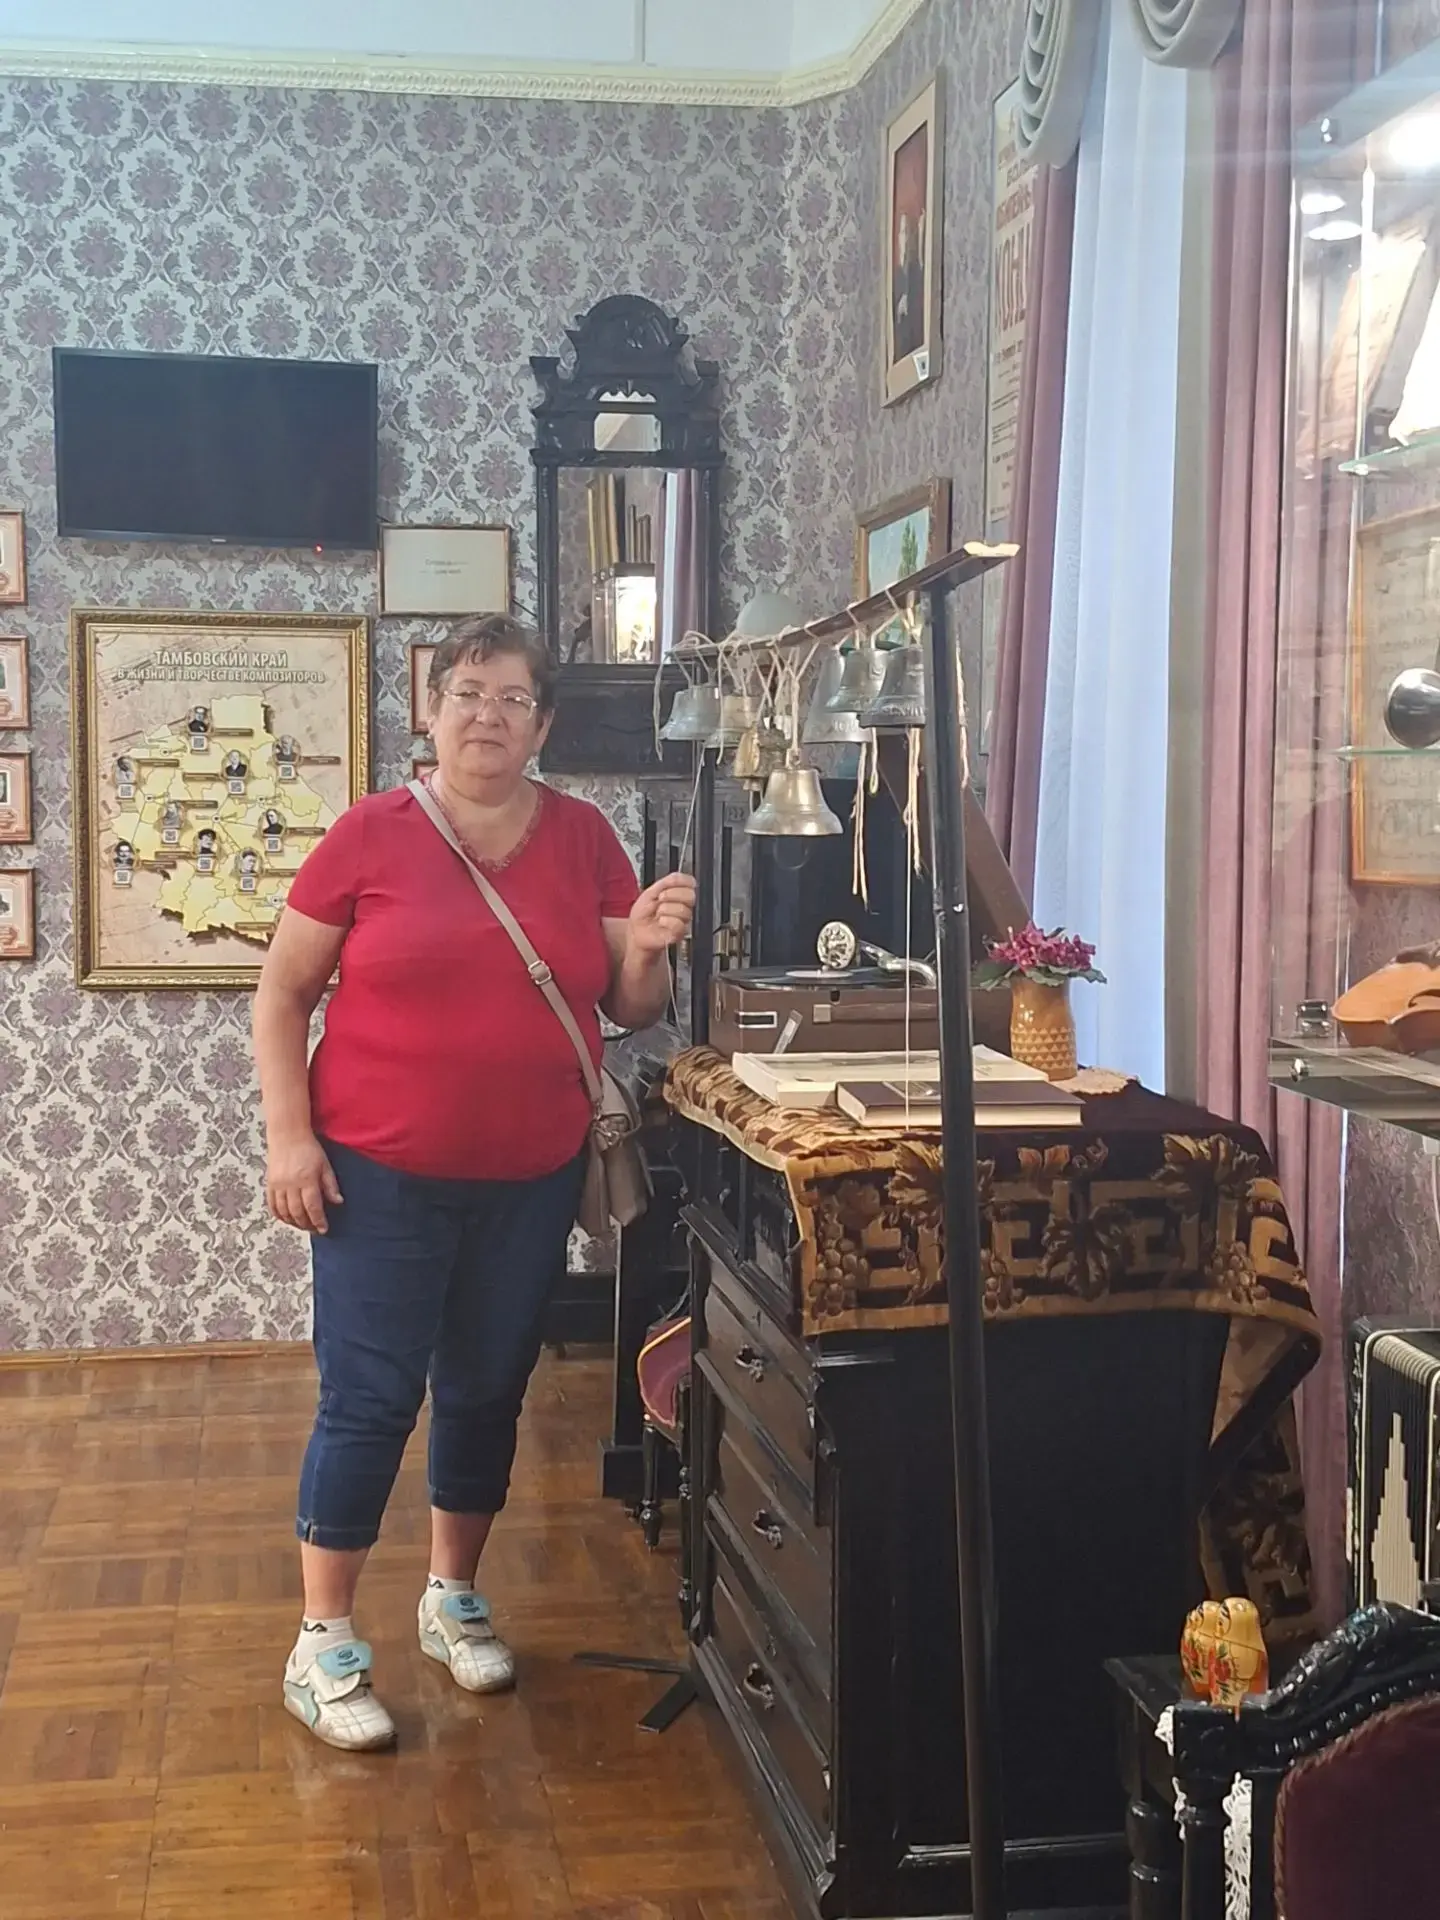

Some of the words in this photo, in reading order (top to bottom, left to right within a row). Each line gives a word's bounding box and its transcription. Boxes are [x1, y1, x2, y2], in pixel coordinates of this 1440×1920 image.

[155, 650, 248, 667] ТАМБОВСКИЙ
[252, 649, 288, 668] КРАЙ
[118, 668, 125, 679] В
[127, 668, 165, 680] ЖИЗНИ
[168, 669, 175, 680] И
[178, 669, 241, 682] ТВОРЧЕСТВЕ
[243, 670, 326, 683] КОМПОЗИТОРОВ
